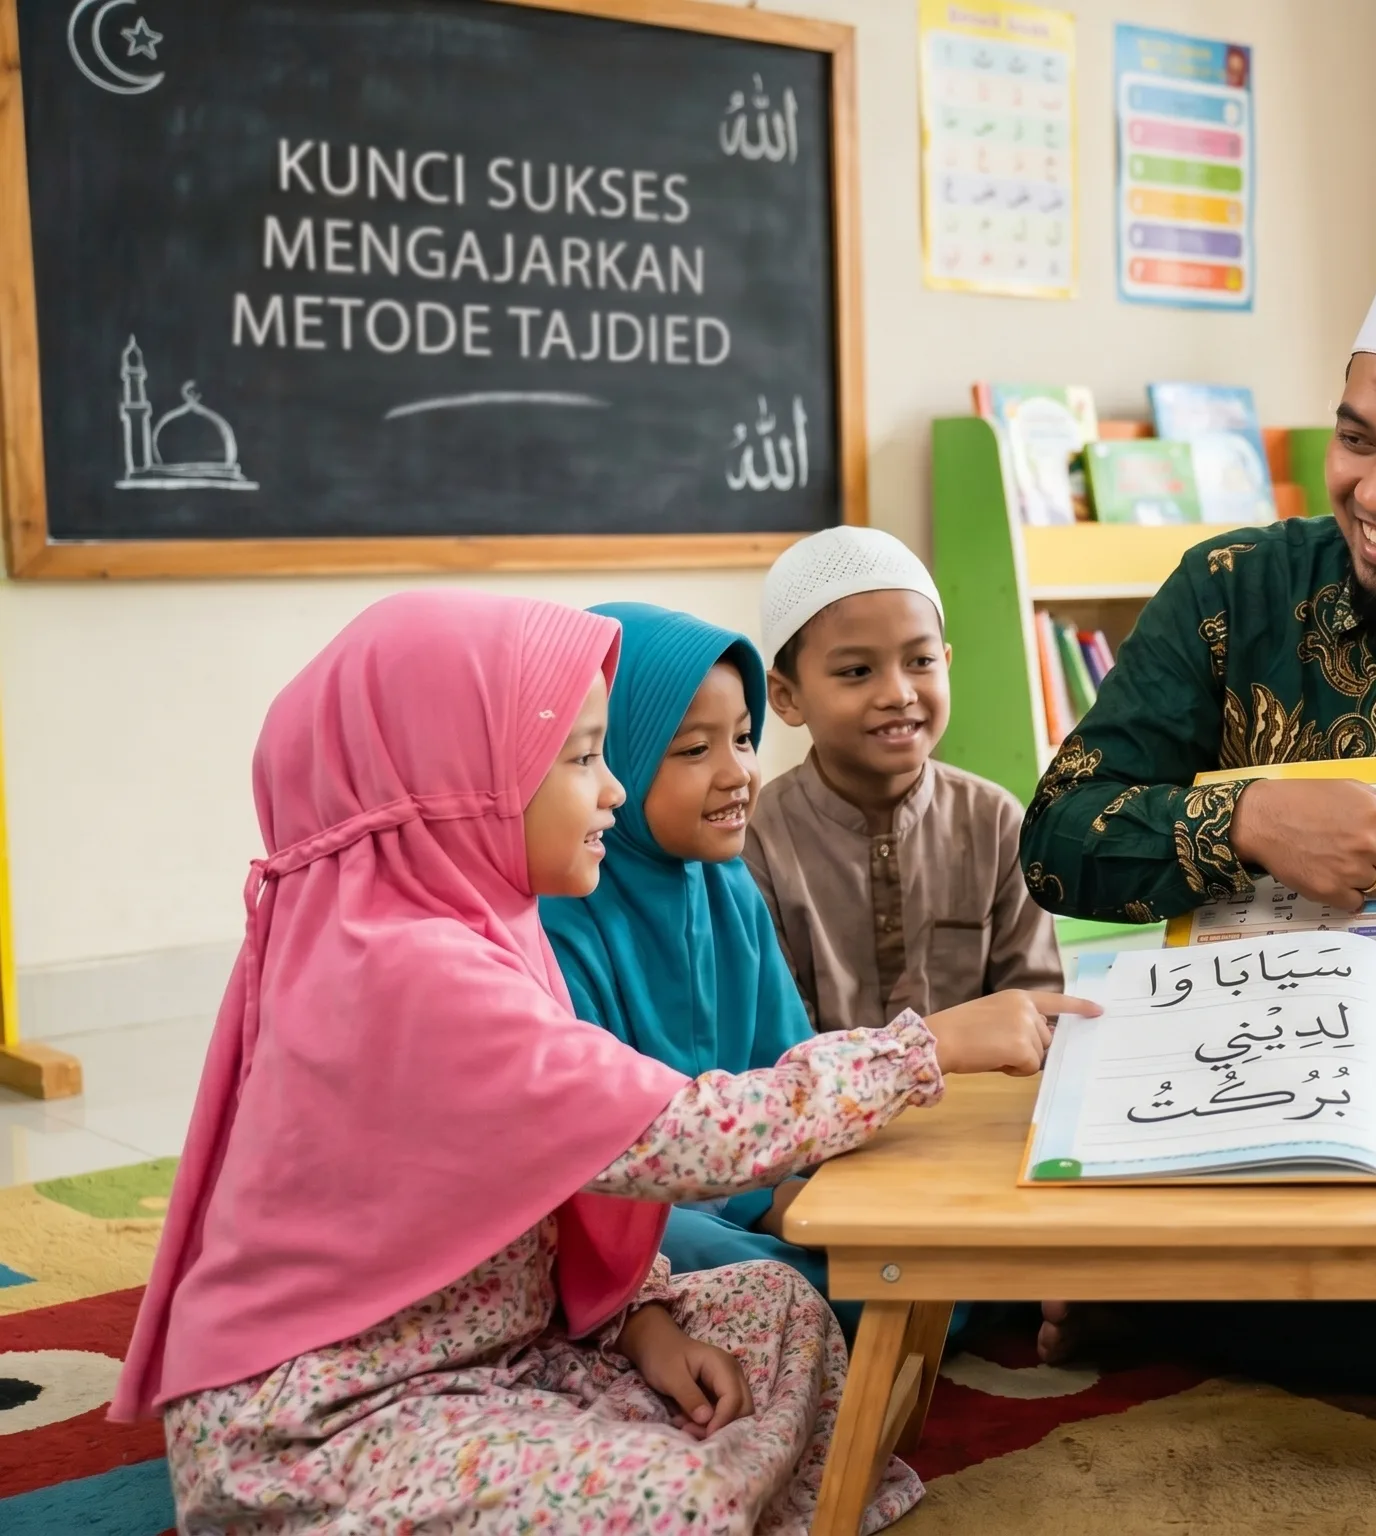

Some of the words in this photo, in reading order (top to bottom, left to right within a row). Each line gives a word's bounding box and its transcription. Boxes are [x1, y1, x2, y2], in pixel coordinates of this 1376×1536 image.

[278, 138, 465, 206] KUNCI
[487, 156, 691, 224] SUKSES
[263, 215, 704, 295] MENGAJARKAN
[231, 293, 492, 357] METODE
[507, 306, 731, 367] TAJDIED
